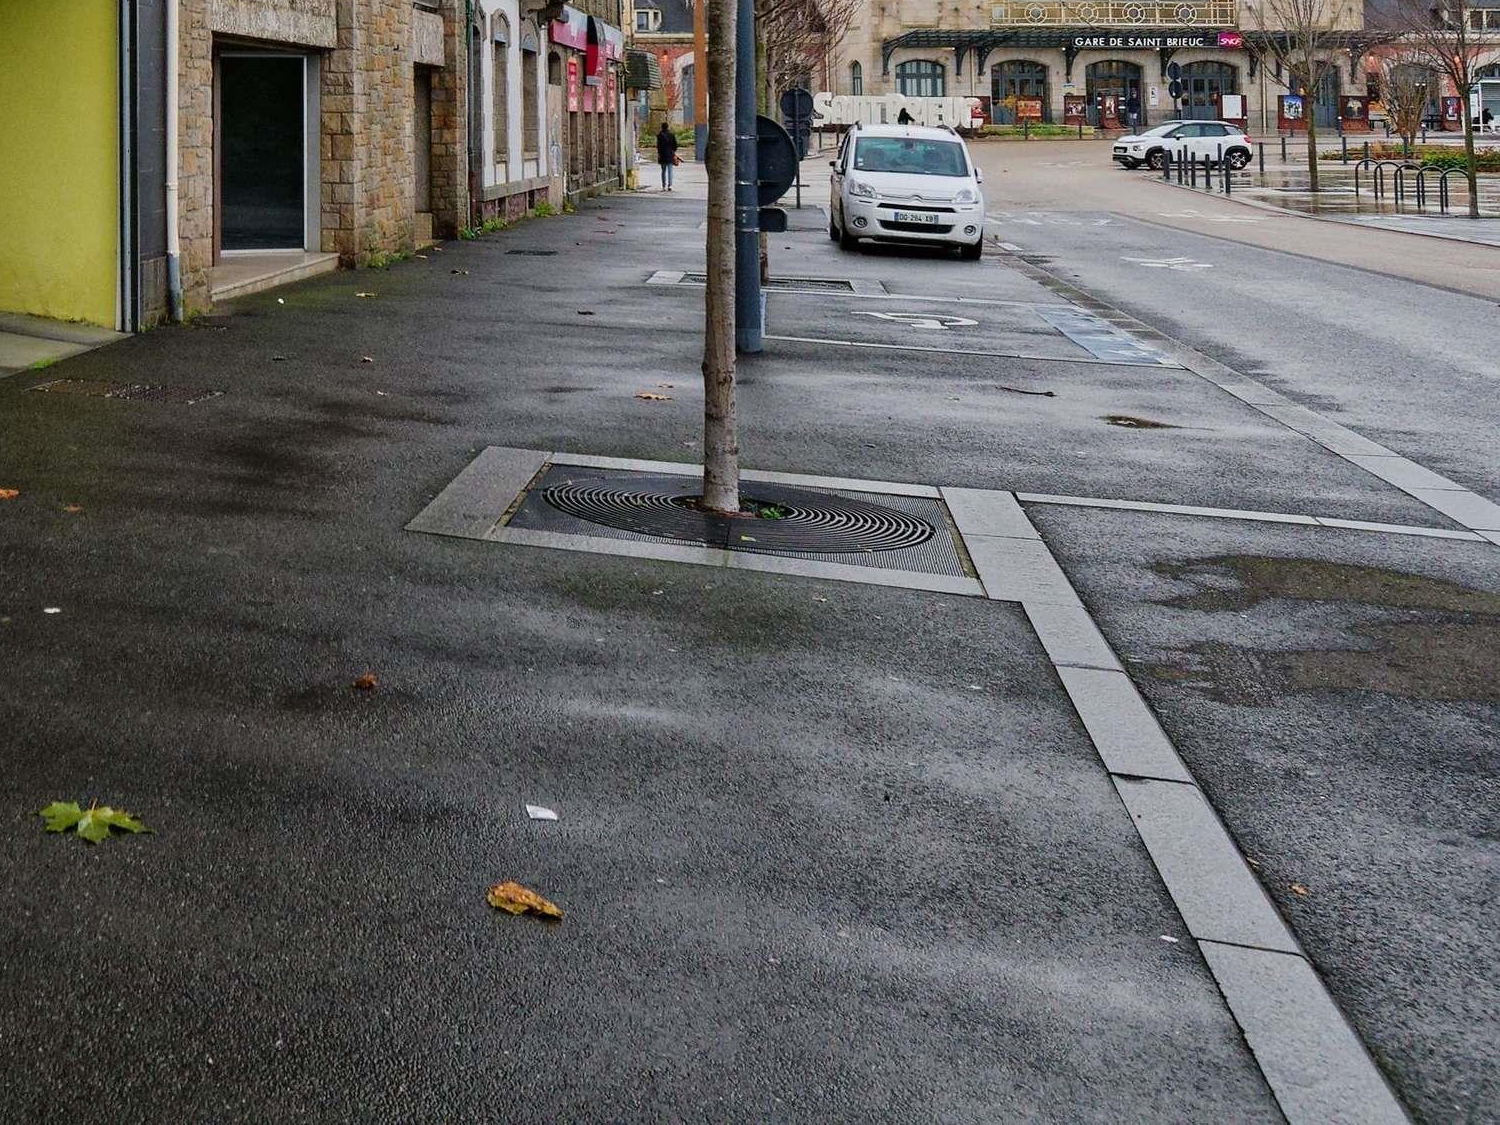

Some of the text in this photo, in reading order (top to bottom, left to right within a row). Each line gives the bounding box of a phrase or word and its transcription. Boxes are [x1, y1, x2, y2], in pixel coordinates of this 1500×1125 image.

[1074, 37, 1204, 47] GARE DE SAINT BRIEUC
